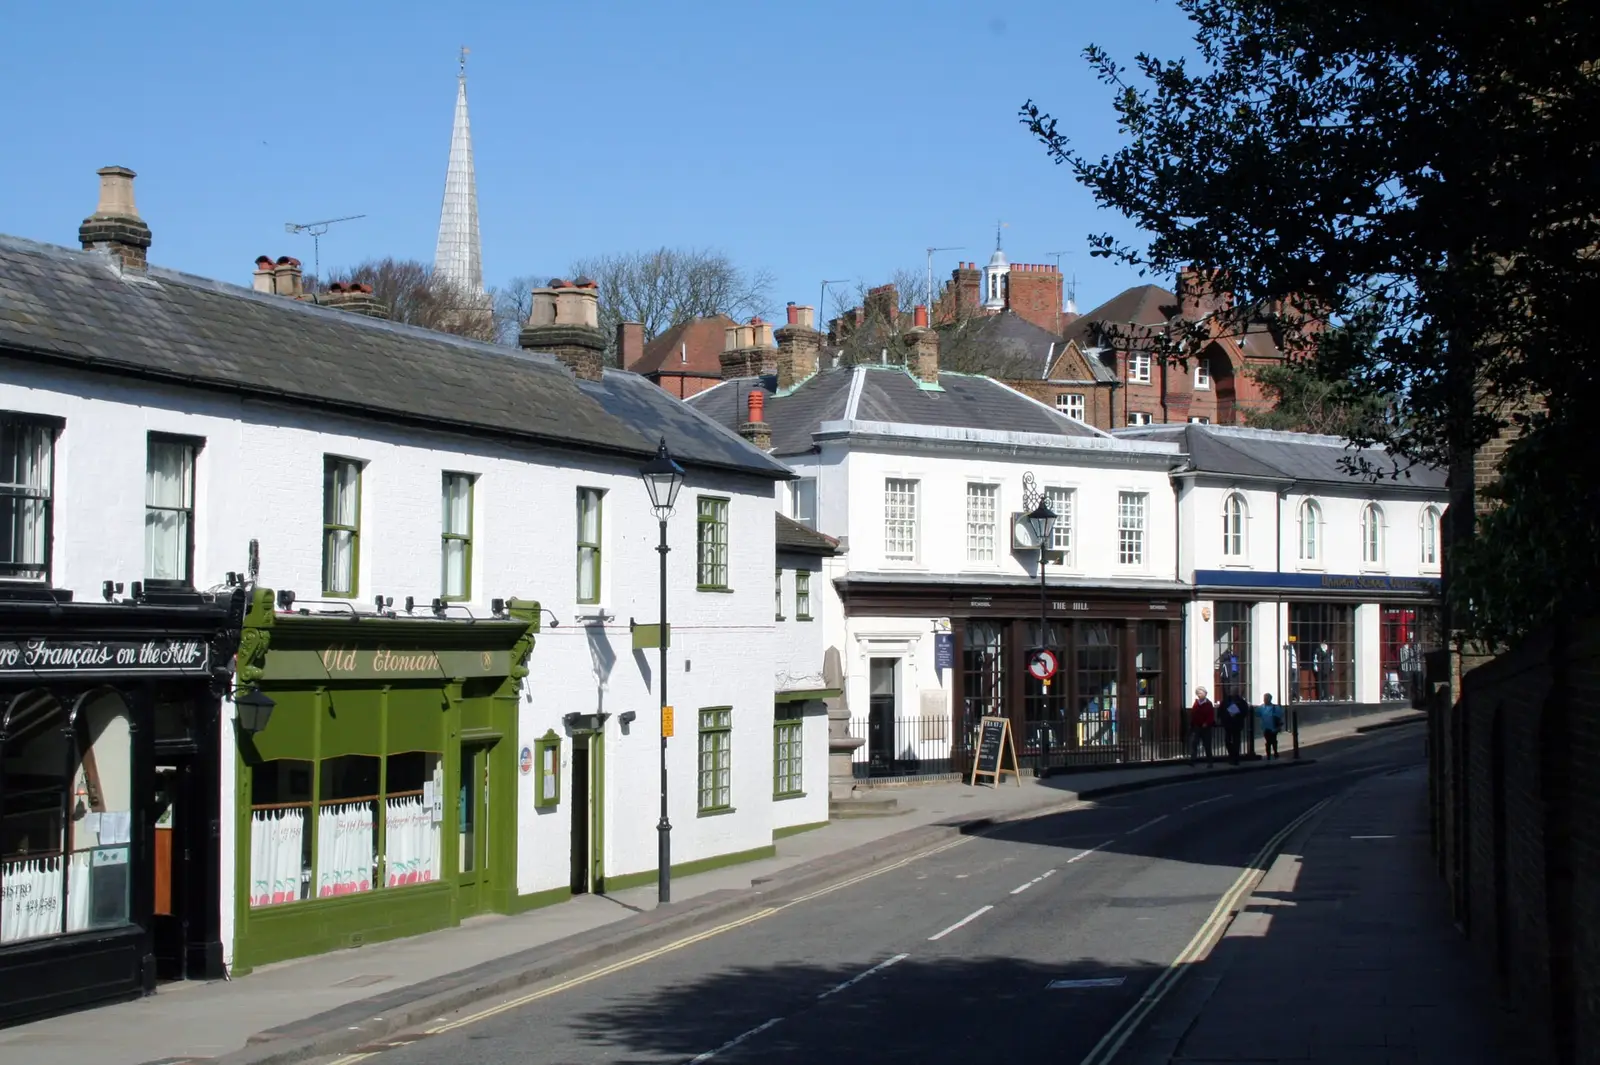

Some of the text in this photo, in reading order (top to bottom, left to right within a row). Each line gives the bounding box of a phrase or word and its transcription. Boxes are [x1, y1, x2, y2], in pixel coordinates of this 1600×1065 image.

[1052, 602, 1089, 610] THE HILL
[25, 639, 113, 668] Français
[116, 648, 136, 664] on
[139, 641, 159, 664] the
[160, 640, 200, 664] Hill
[323, 644, 439, 672] Old Etonian
[2, 883, 31, 898] BISTRO
